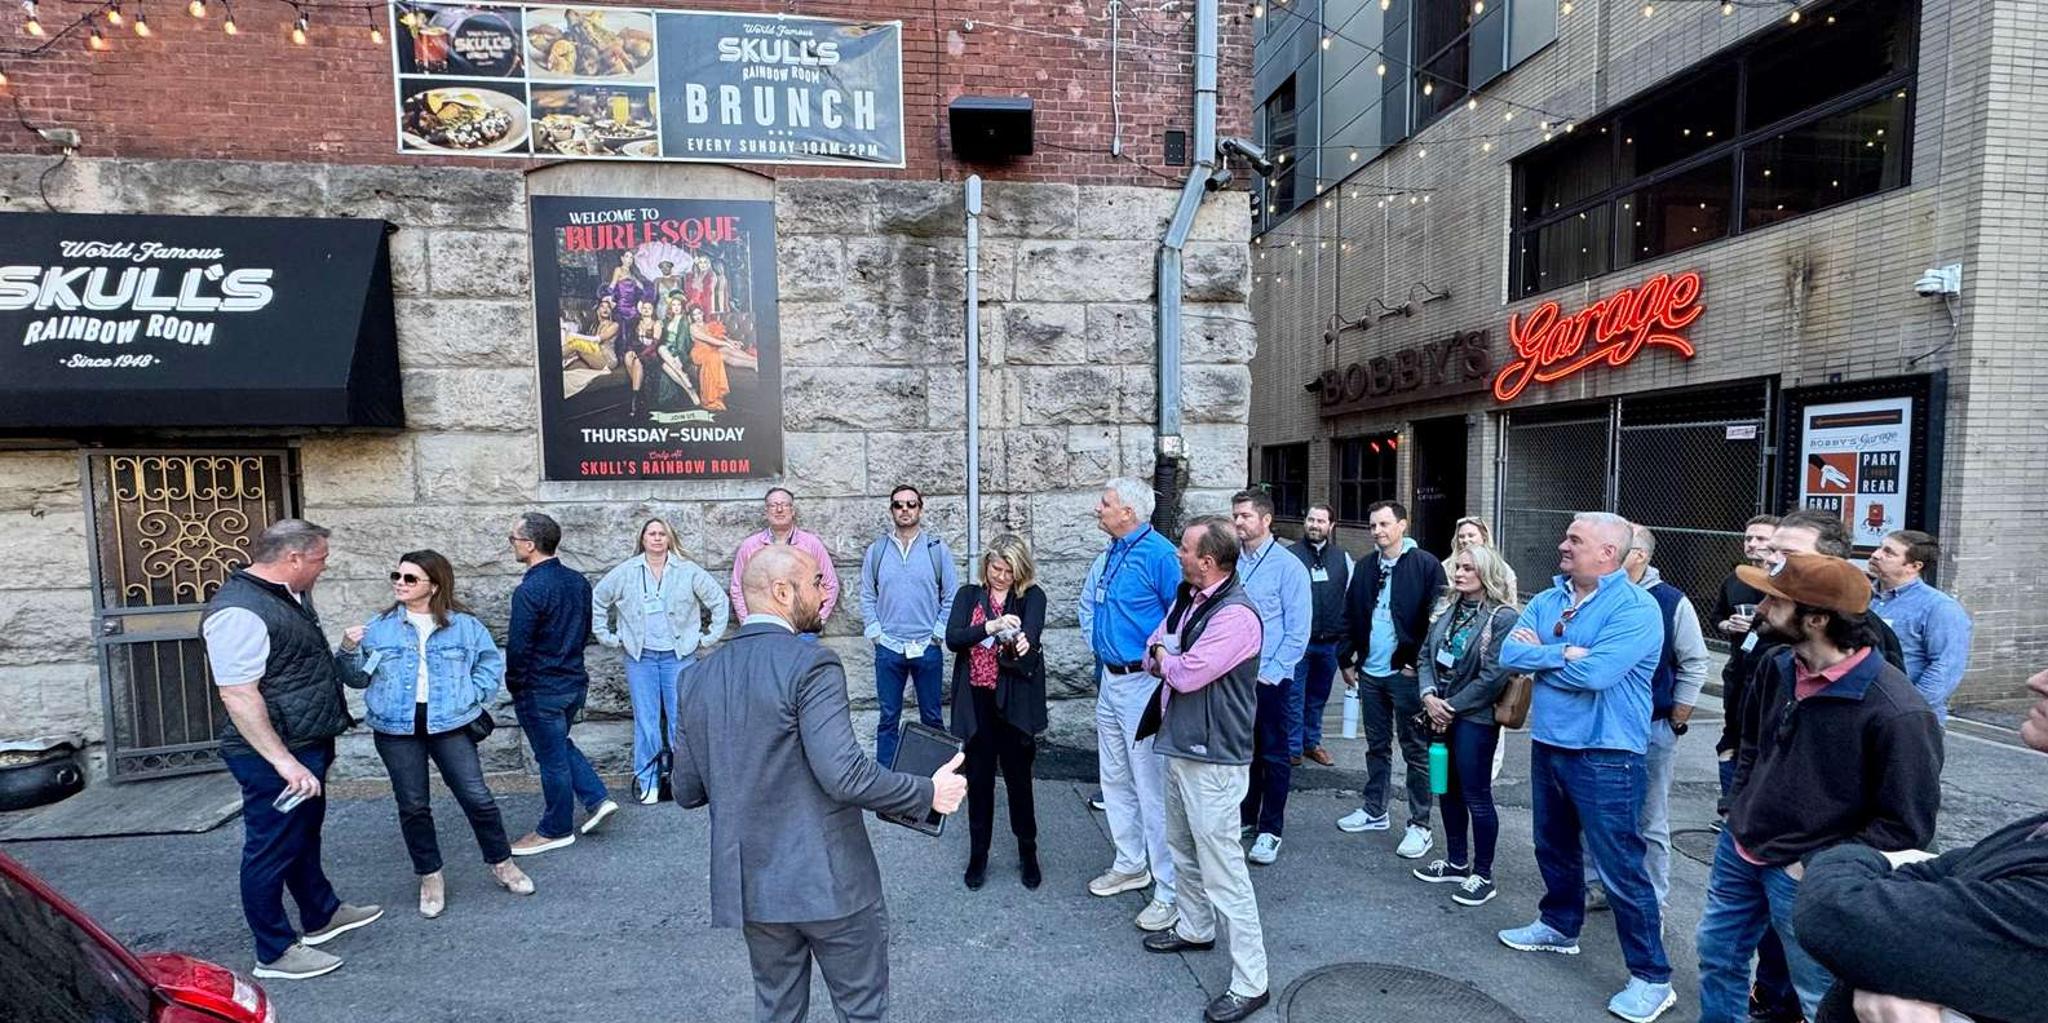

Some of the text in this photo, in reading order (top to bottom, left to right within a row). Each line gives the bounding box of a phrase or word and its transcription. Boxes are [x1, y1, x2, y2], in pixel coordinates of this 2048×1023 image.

[743, 23, 814, 36] World Famous
[718, 36, 841, 66] SKULL'S
[742, 65, 820, 83] RAINBOW ROOM
[686, 83, 876, 130] BRUNCH
[687, 138, 879, 156] EVERY SUNDAY 10AM-2PM
[569, 207, 660, 225] WELCOME TO
[564, 216, 741, 251] BURLESQUE
[60, 240, 225, 262] World Famous
[0, 264, 274, 312] SKULL'S
[23, 314, 215, 346] RAINBOW ROOM
[1494, 272, 1703, 401] Garage
[67, 354, 152, 368] Since 1948
[1320, 330, 1491, 406] BOBBY'S
[580, 459, 750, 475] SKULL'S RAINBOW ROOM
[1863, 453, 1897, 466] PARK
[1862, 479, 1895, 493] REAR
[1809, 498, 1839, 511] GRAB
